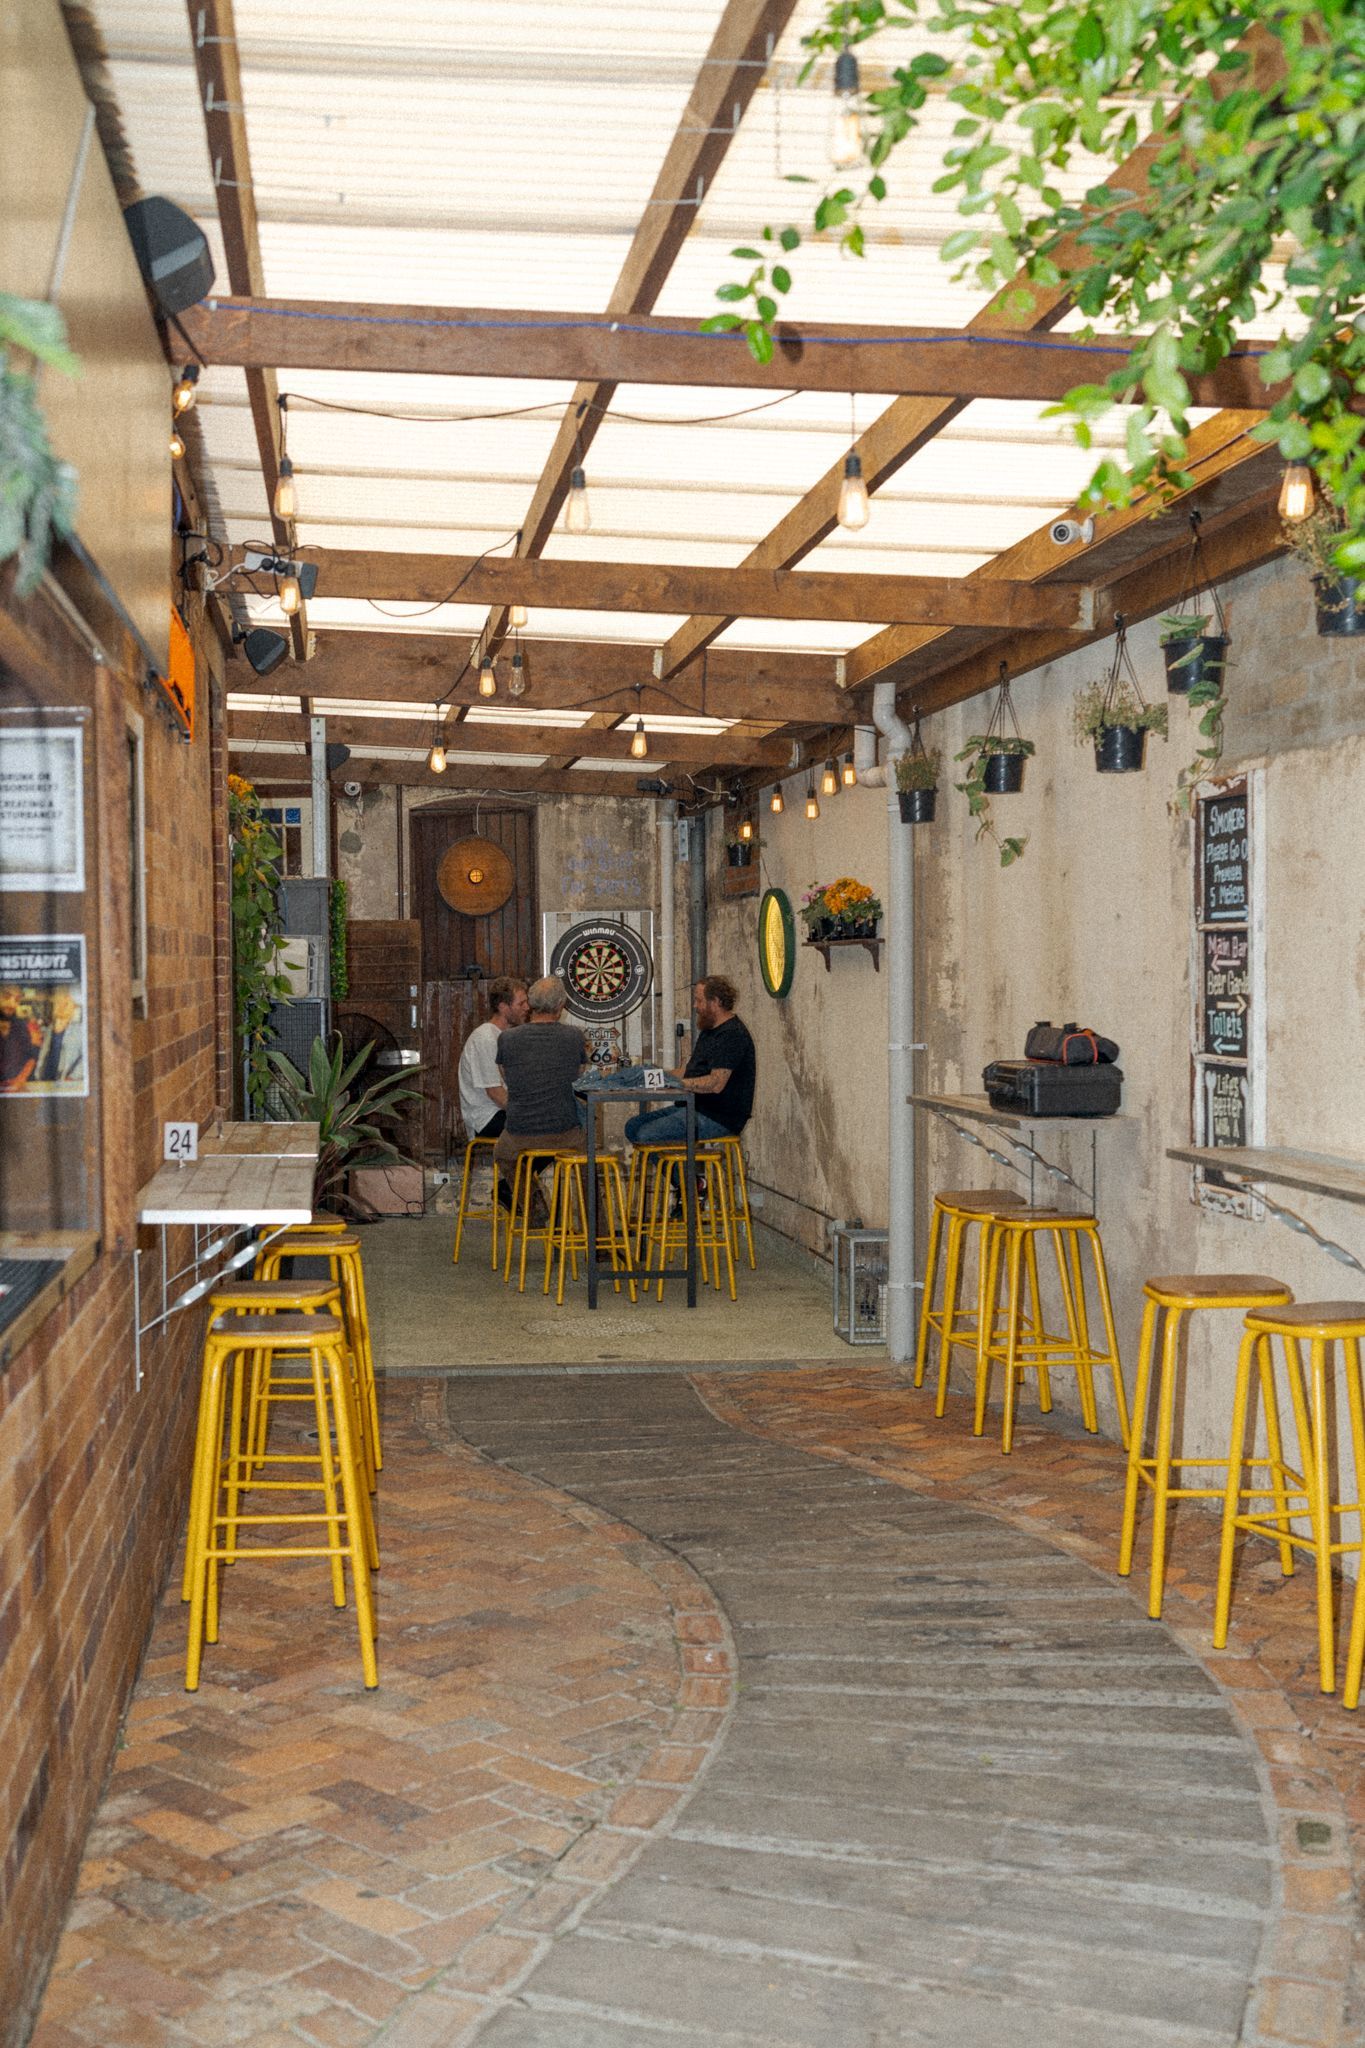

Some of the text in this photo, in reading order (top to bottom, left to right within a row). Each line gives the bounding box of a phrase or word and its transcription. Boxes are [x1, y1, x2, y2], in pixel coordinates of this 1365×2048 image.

[1229, 838, 1240, 861] Go
[582, 927, 616, 936] WINMAU
[1207, 935, 1230, 956] Main
[0, 954, 68, 969] NSTEADY?
[1207, 1009, 1244, 1039] Toilets
[589, 1030, 615, 1039] ROUTE
[590, 1048, 613, 1063] 66
[647, 1072, 662, 1085] 21
[170, 1129, 192, 1154] 24
